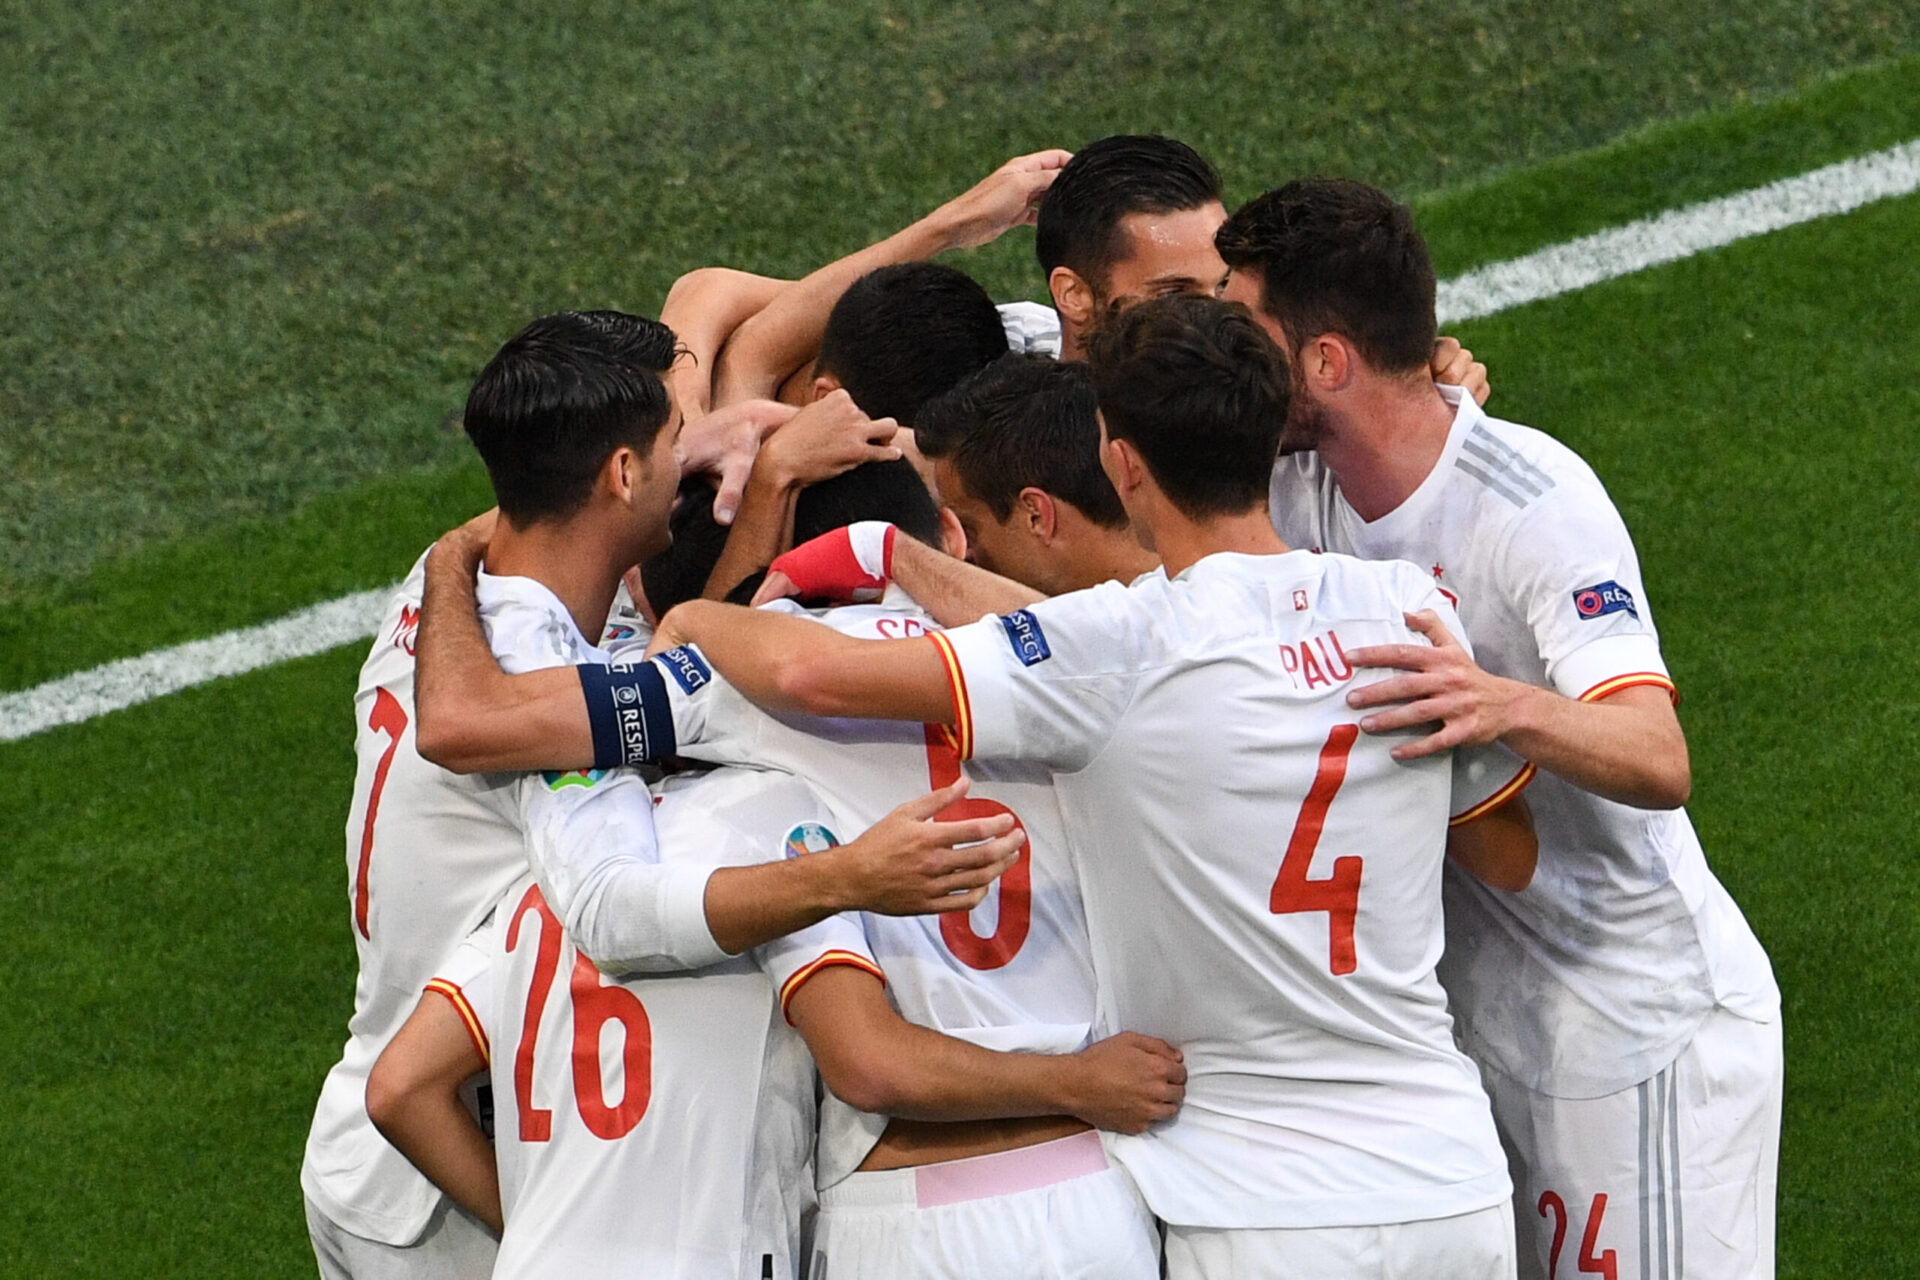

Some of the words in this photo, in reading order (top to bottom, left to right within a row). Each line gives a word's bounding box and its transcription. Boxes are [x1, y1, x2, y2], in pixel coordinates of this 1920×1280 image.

[1007, 609, 1043, 662] SPECT
[1278, 629, 1353, 690] PAU
[355, 685, 409, 942] 7
[1269, 723, 1364, 976] 4
[505, 882, 653, 1142] 26
[1537, 1190, 1618, 1280] 24
